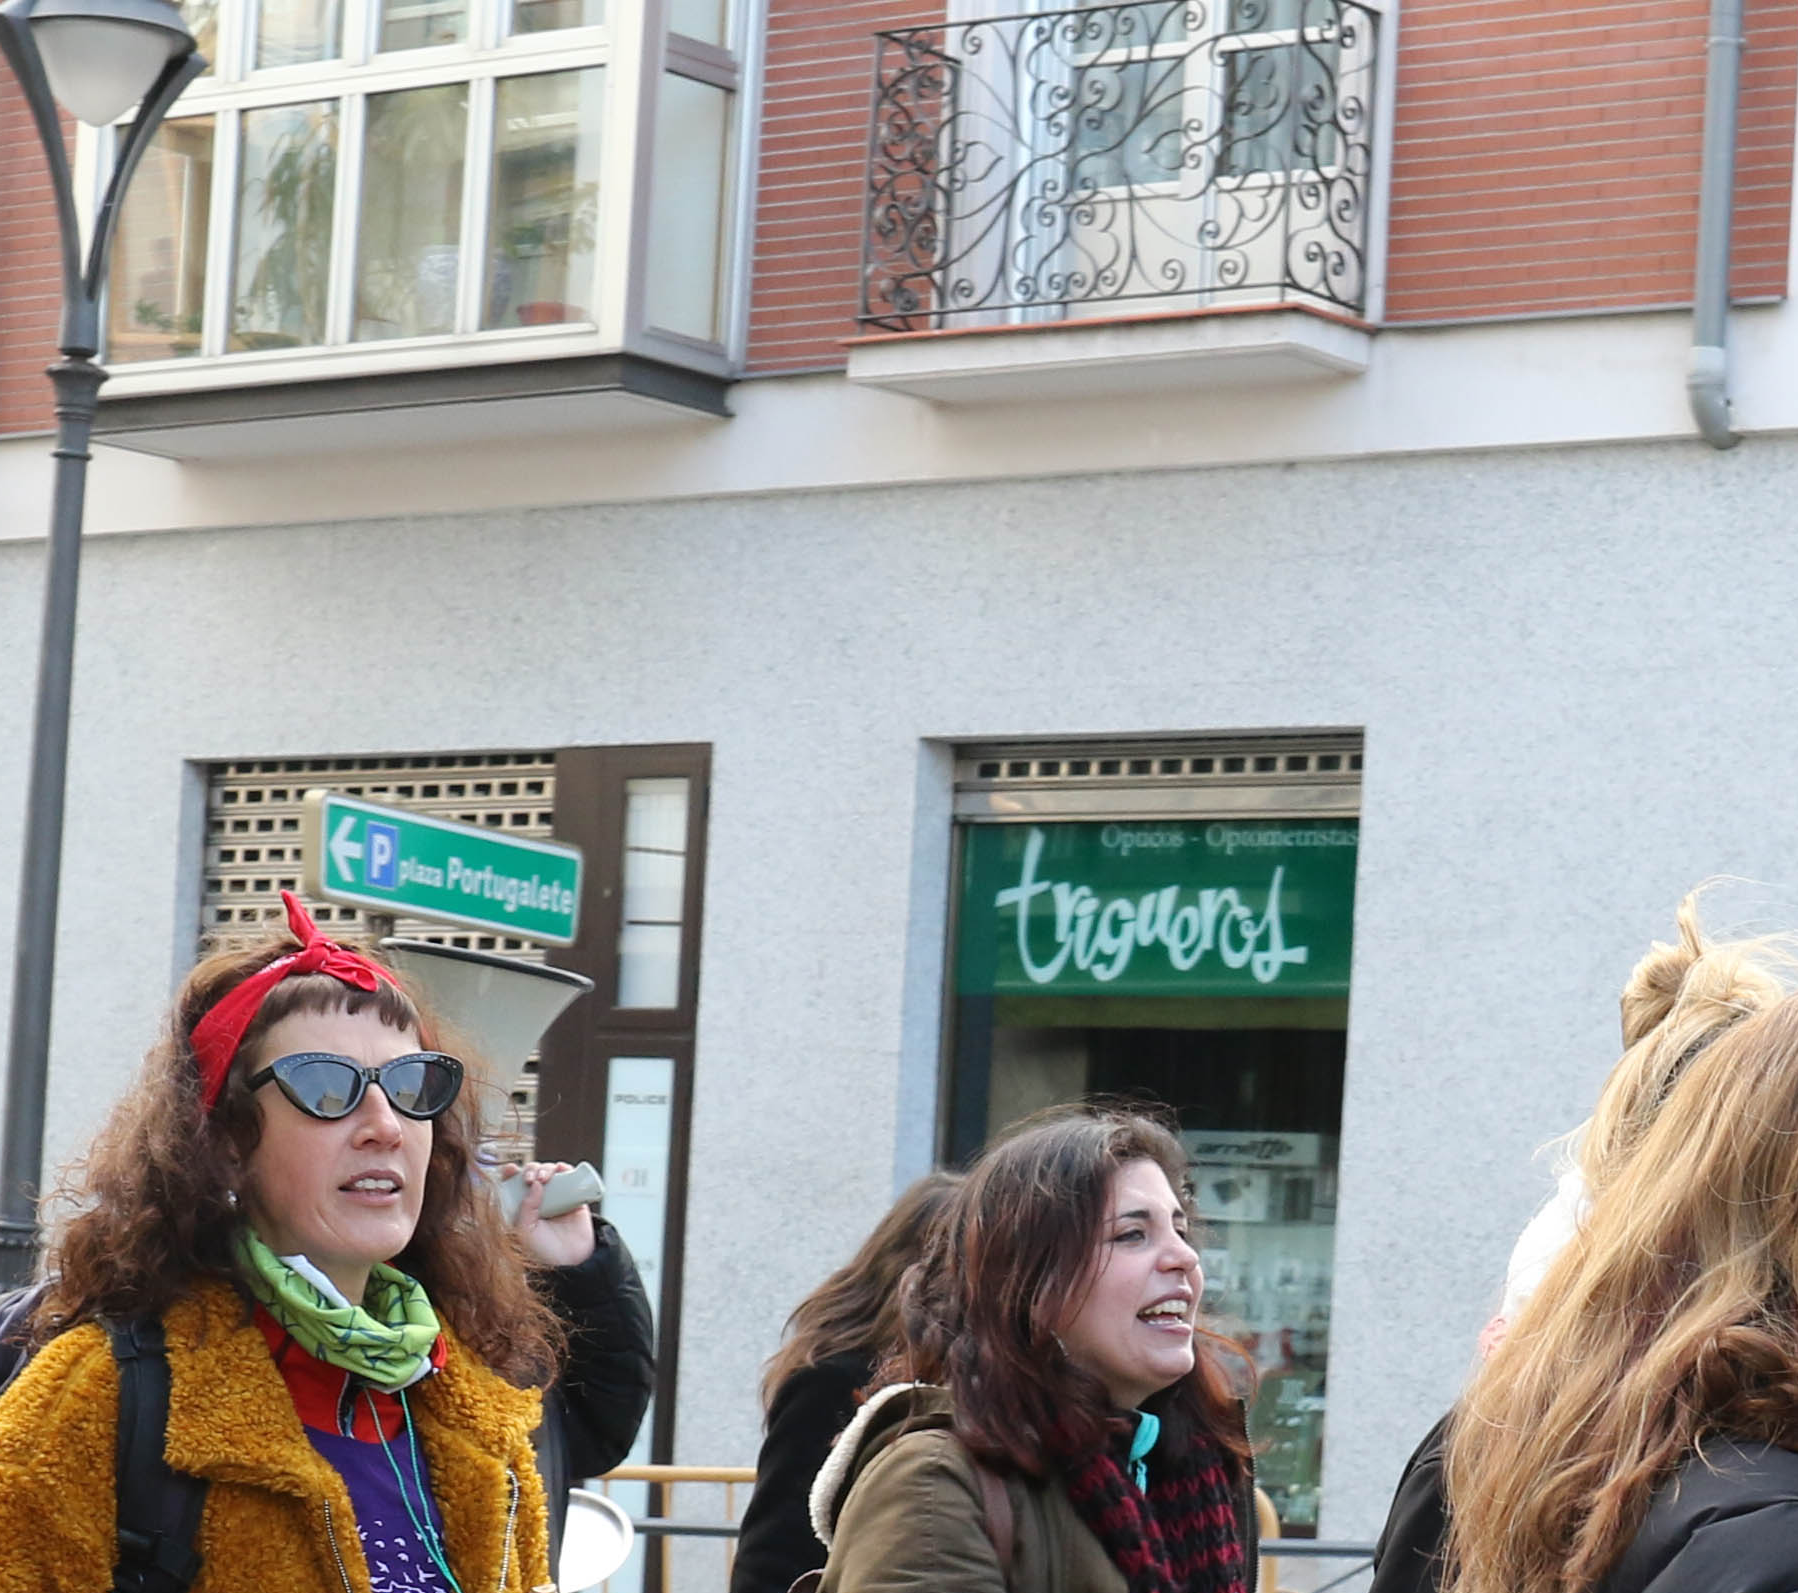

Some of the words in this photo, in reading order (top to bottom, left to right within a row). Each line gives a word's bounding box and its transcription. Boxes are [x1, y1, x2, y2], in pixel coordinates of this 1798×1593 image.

[371, 833, 393, 879] P
[399, 857, 444, 888] plaza
[447, 856, 572, 914] Portugalete
[614, 1094, 667, 1105] POLICE
